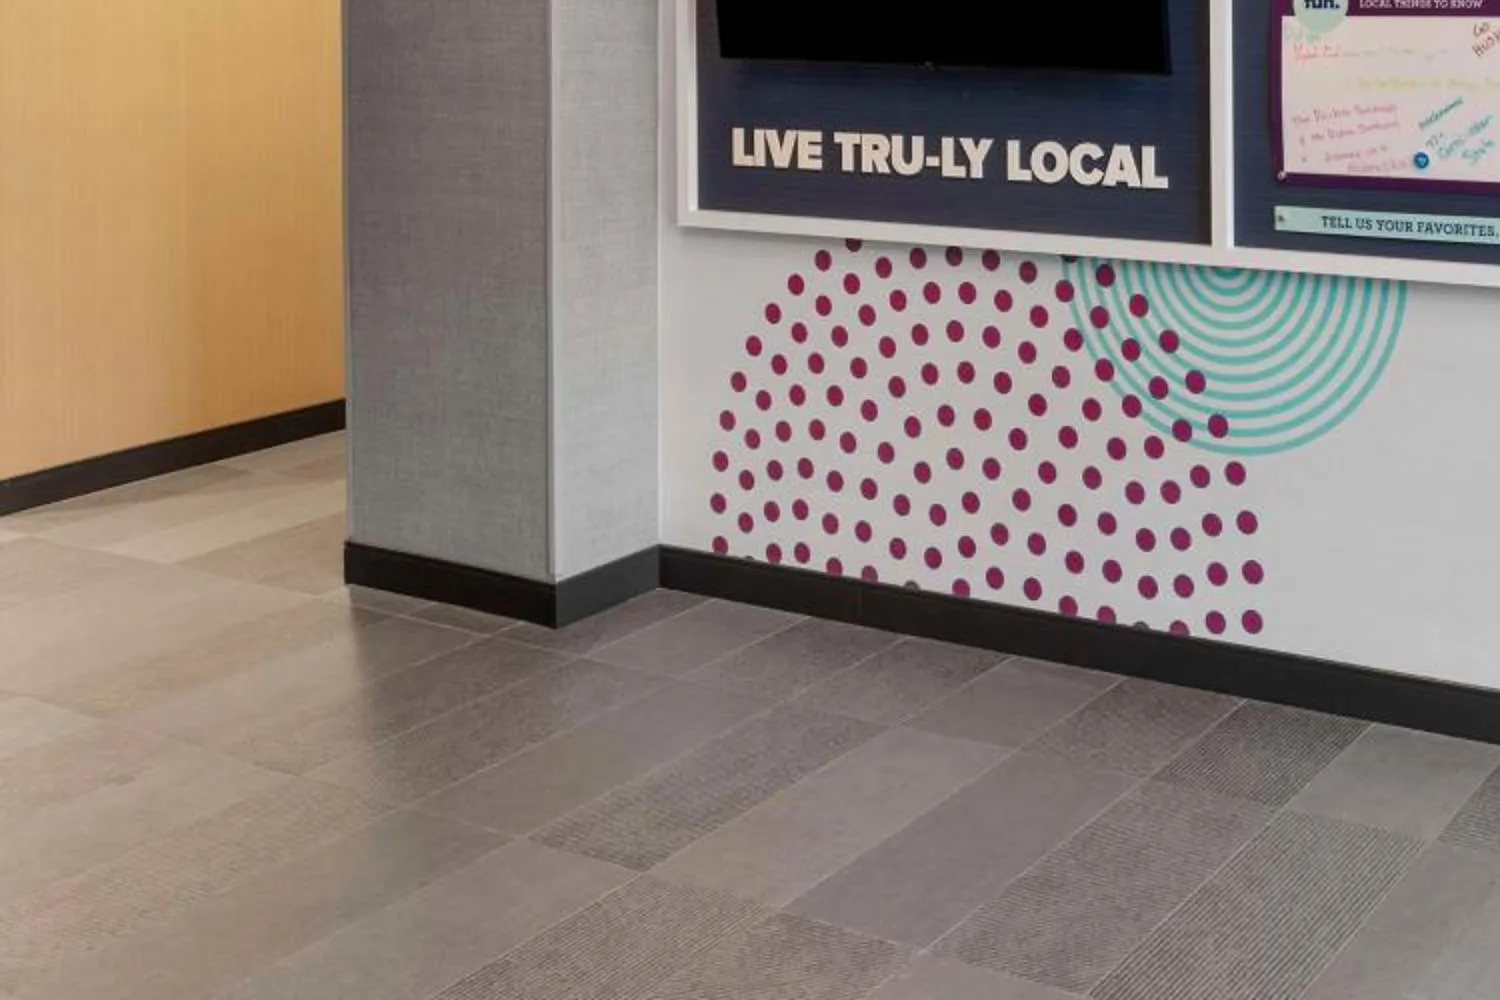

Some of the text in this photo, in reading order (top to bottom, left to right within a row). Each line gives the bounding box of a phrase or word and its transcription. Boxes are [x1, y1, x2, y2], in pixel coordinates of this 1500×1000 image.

[1359, 0, 1483, 9] LOCAL THINGS TO KNOW
[731, 127, 1169, 189] LIVE TRU-LY LOCAL
[1321, 215, 1500, 239] TELL US YOUR FAVORITES.
